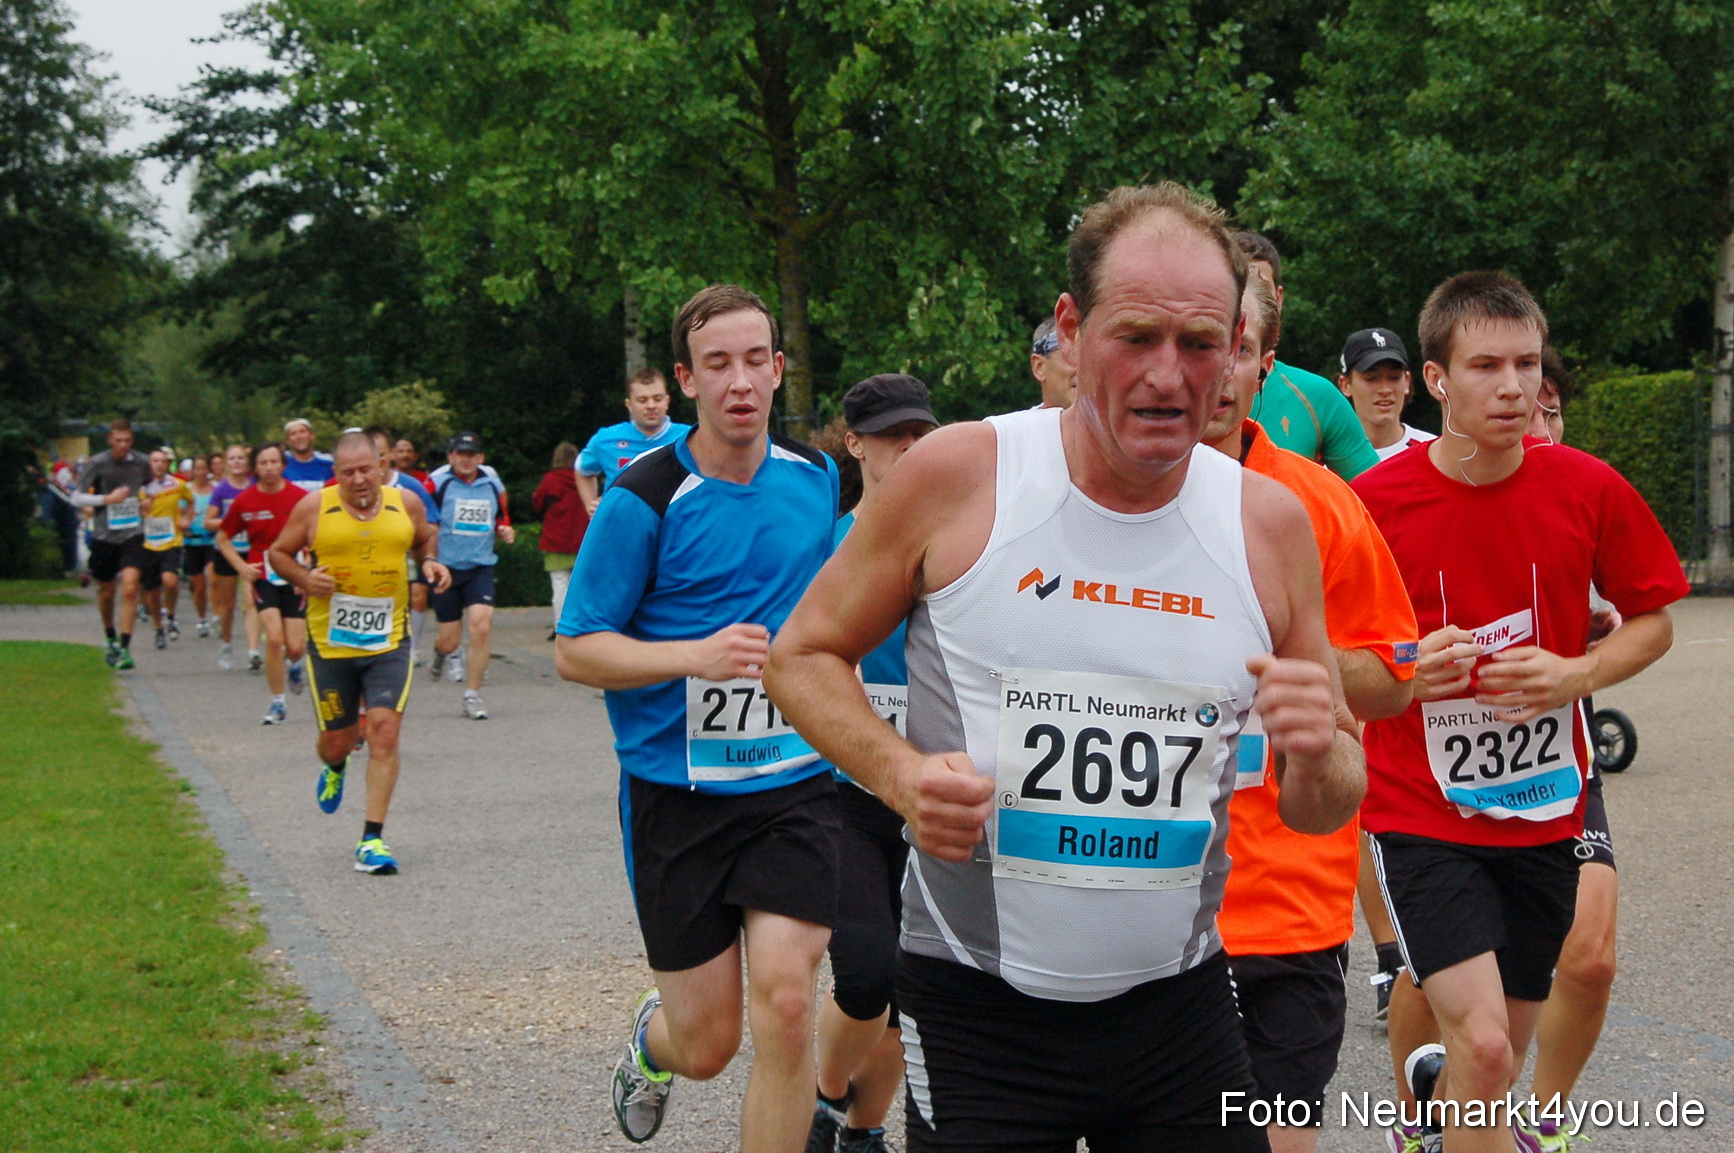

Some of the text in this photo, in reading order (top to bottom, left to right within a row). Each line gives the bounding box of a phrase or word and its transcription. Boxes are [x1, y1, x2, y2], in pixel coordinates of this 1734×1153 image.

[1073, 580, 1215, 619] KLEBL
[337, 608, 386, 631] 2890
[702, 687, 792, 732] 271
[1006, 690, 1187, 723] PARTL Neumarkt
[1428, 713, 1478, 728] PARTL
[726, 743, 782, 762] Ludwig
[1020, 723, 1204, 808] 2697
[1445, 717, 1560, 783] 2322
[1058, 825, 1160, 860] Roland
